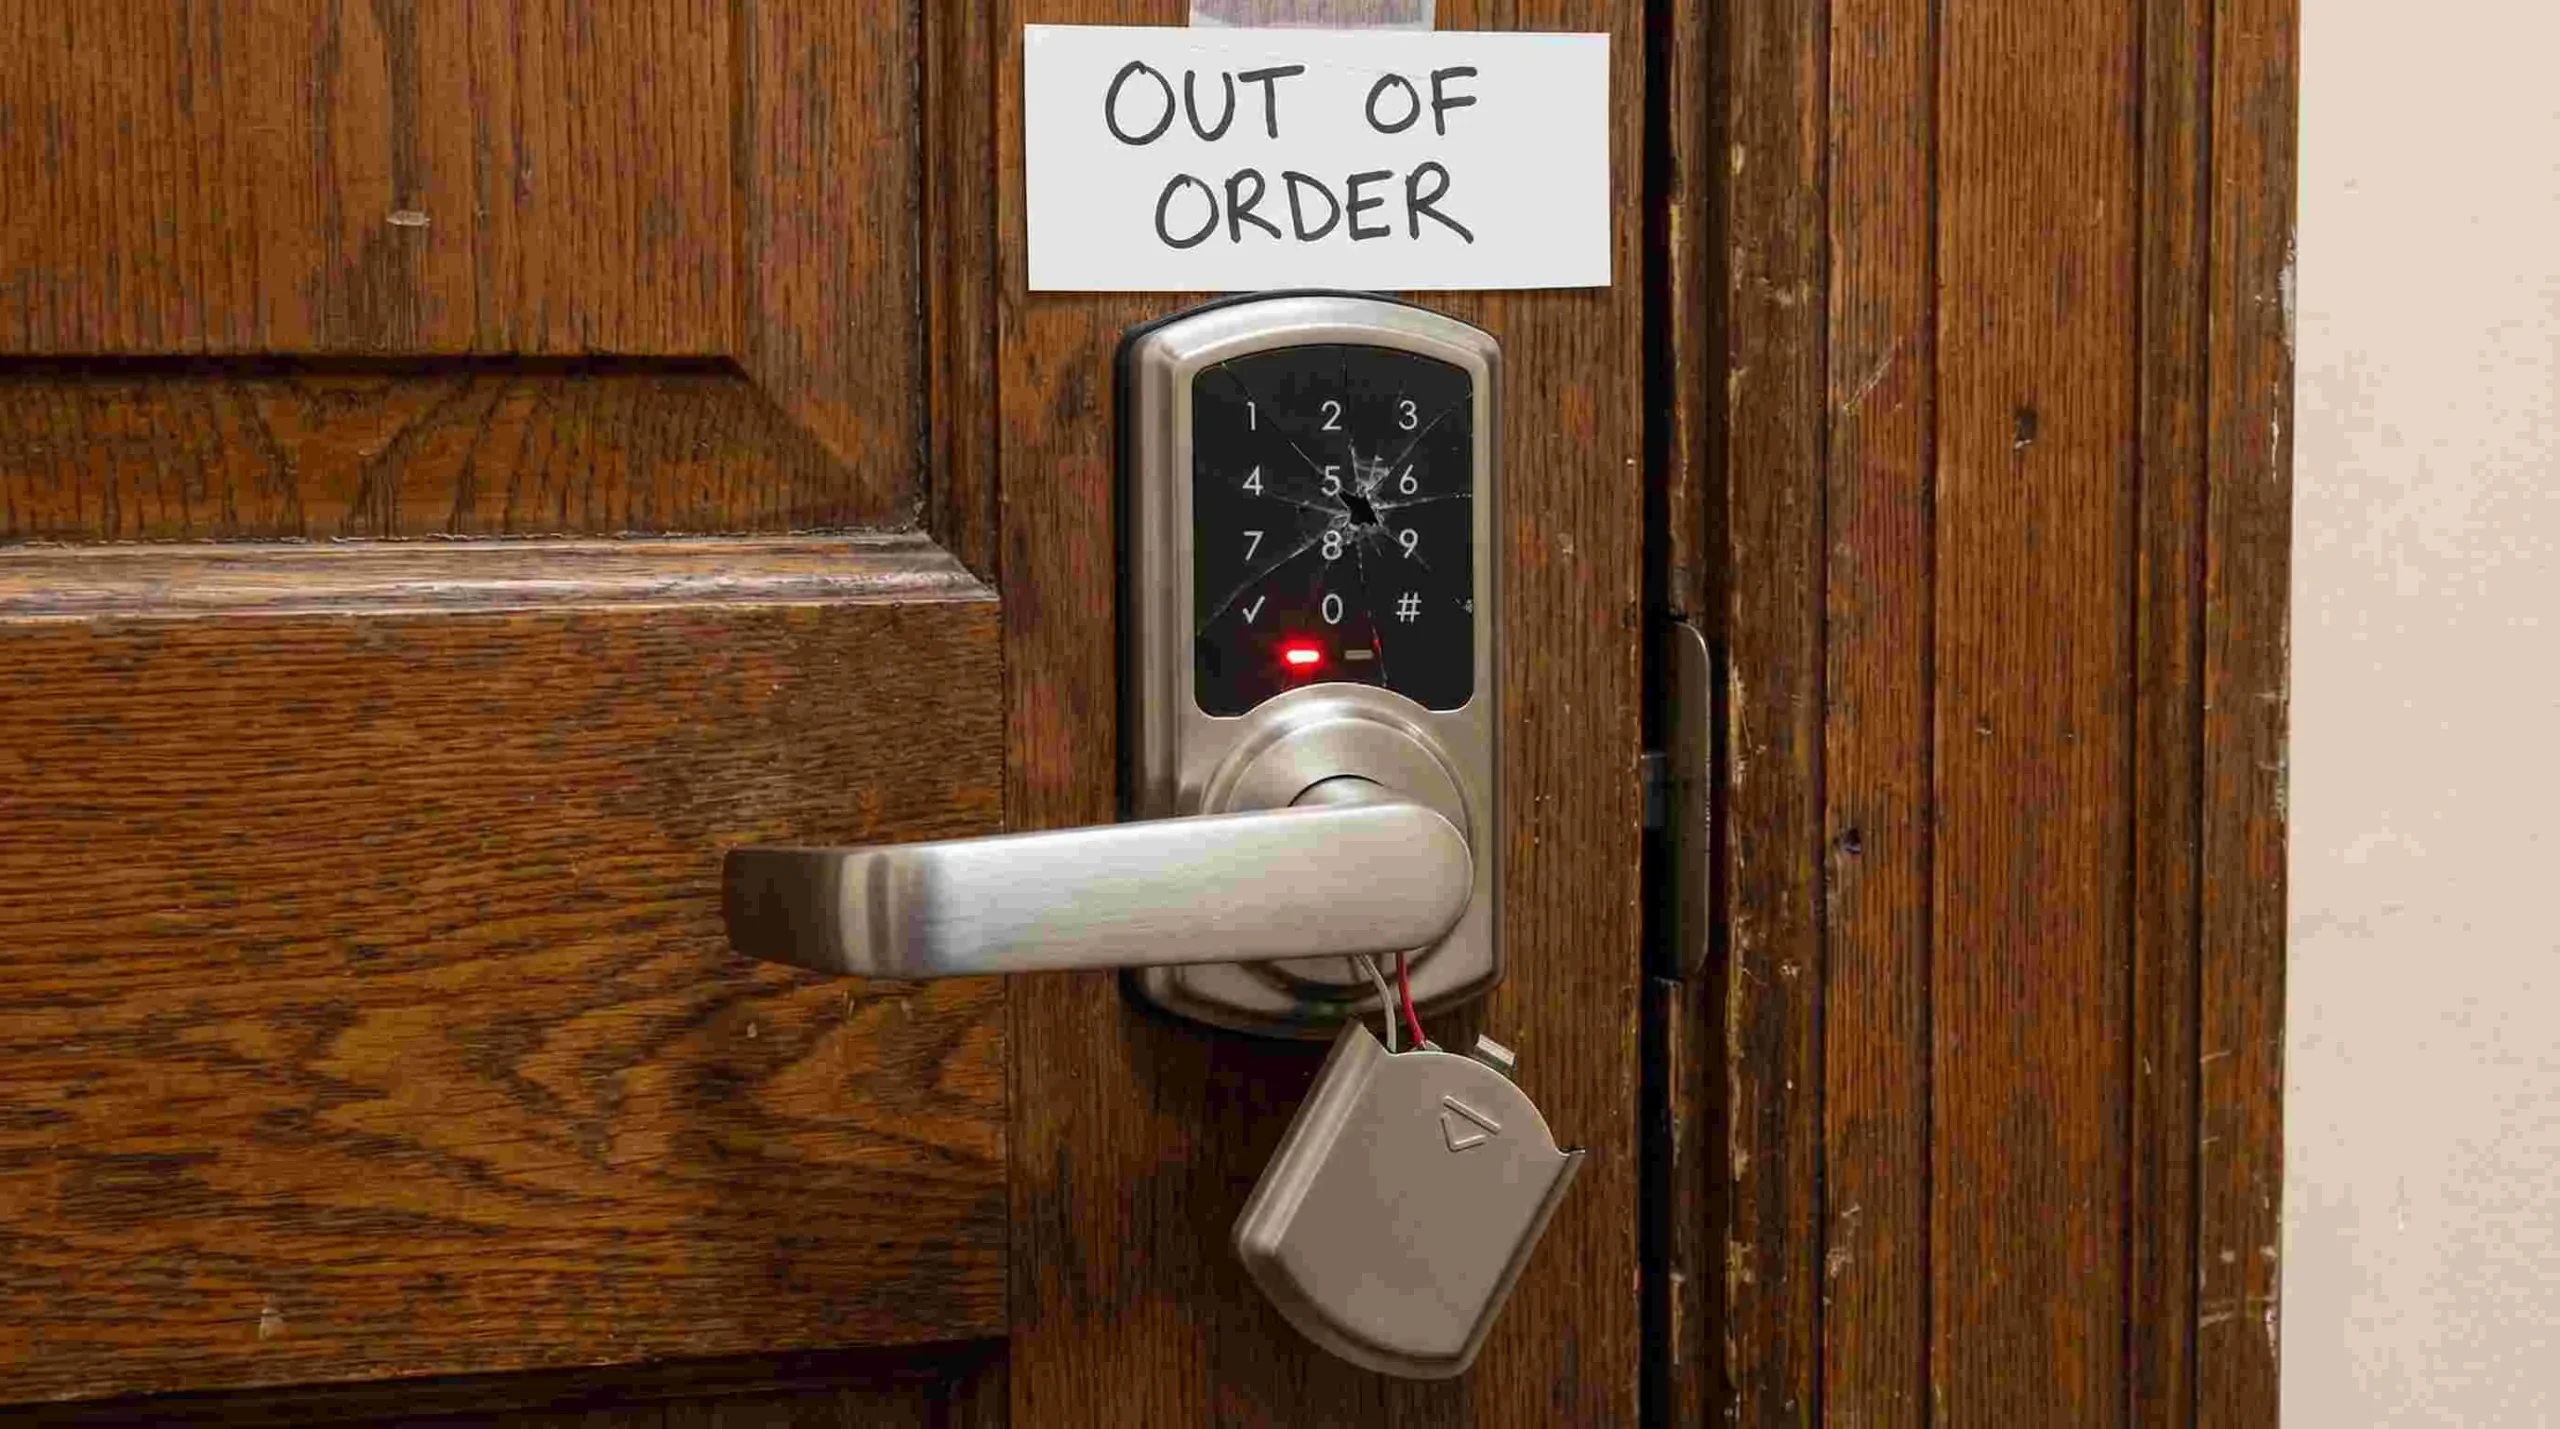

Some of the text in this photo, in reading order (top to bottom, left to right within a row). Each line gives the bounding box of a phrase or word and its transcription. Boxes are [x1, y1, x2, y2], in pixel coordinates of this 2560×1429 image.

[1104, 60, 1478, 146] OUT OF
[1155, 161, 1474, 249] ORDER
[1246, 400, 1418, 431] 1 2 3
[1242, 464, 1418, 496] 4 5 6
[1243, 529, 1419, 561] 7 8 9
[1321, 592, 1421, 624] 0 #
